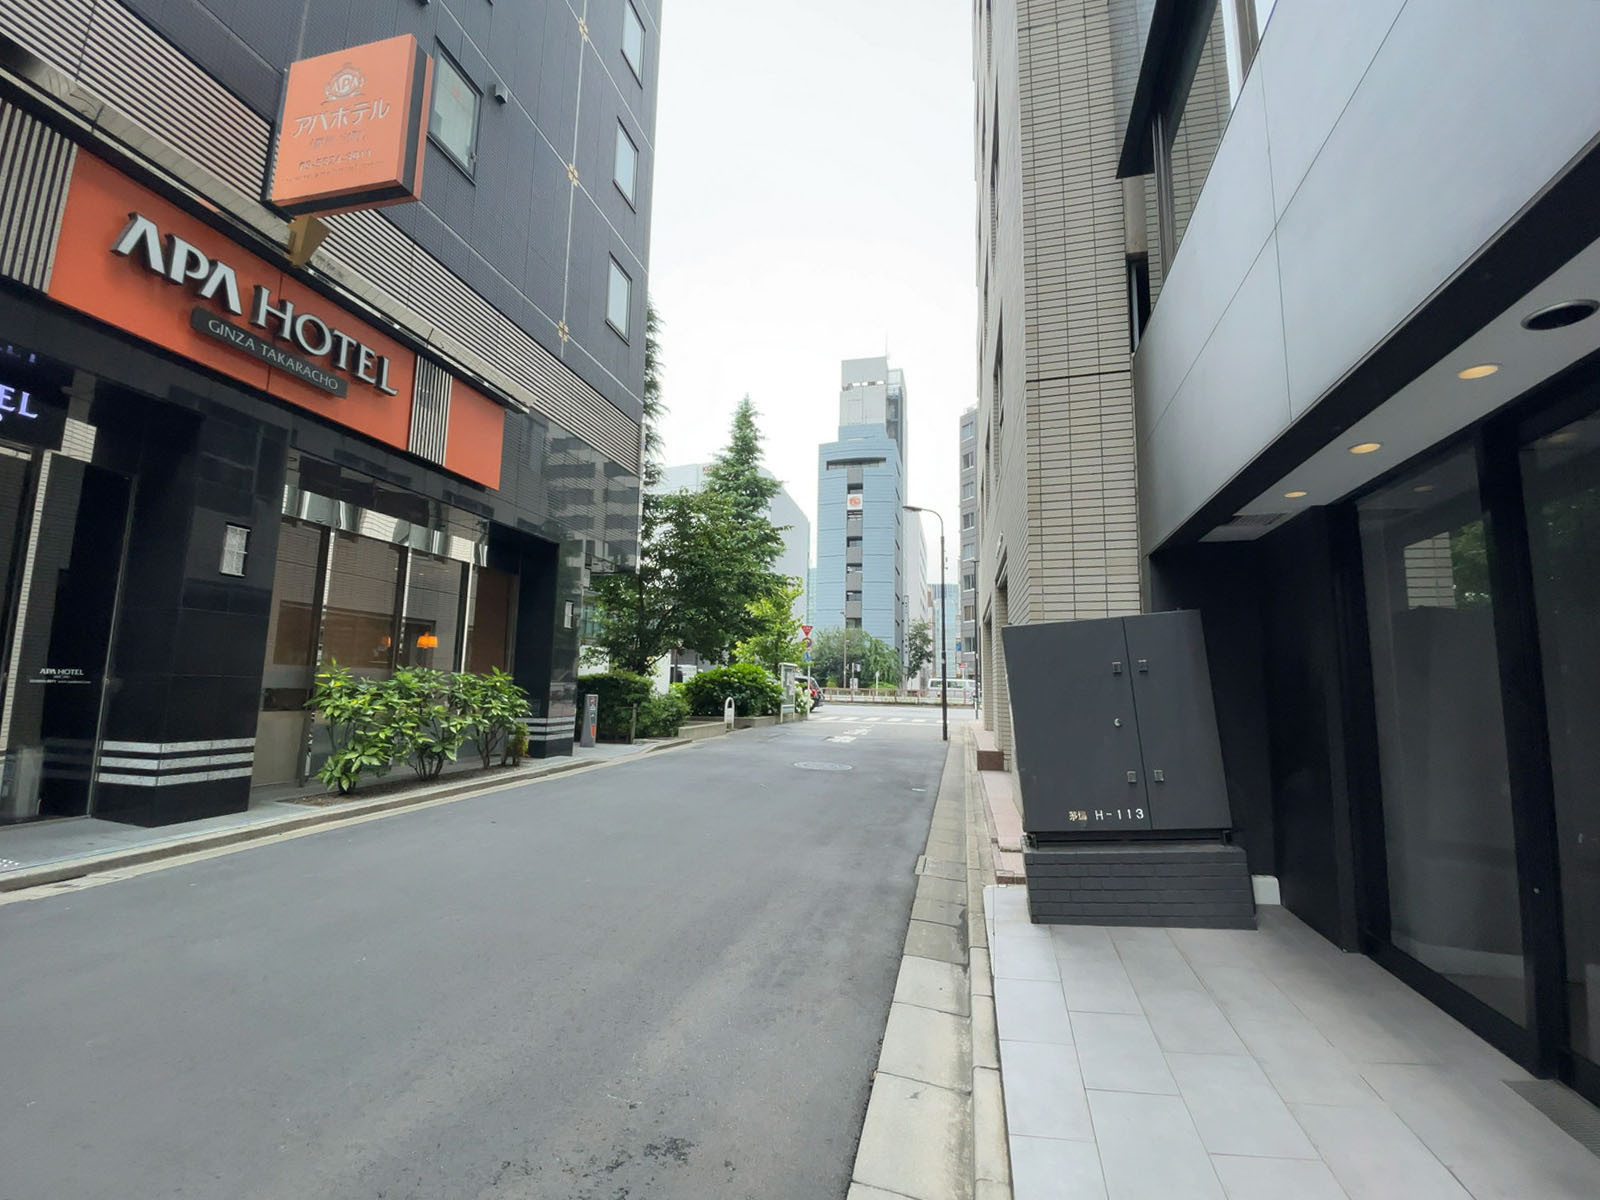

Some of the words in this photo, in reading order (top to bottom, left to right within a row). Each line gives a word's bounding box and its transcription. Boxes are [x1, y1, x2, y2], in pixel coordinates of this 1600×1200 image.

[113, 212, 243, 316] APA
[250, 285, 398, 396] HOTEL
[208, 319, 255, 351] GINZA
[260, 343, 339, 390] TAKARACHO
[57, 668, 85, 676] HOTEL
[1094, 808, 1145, 820] H-113
